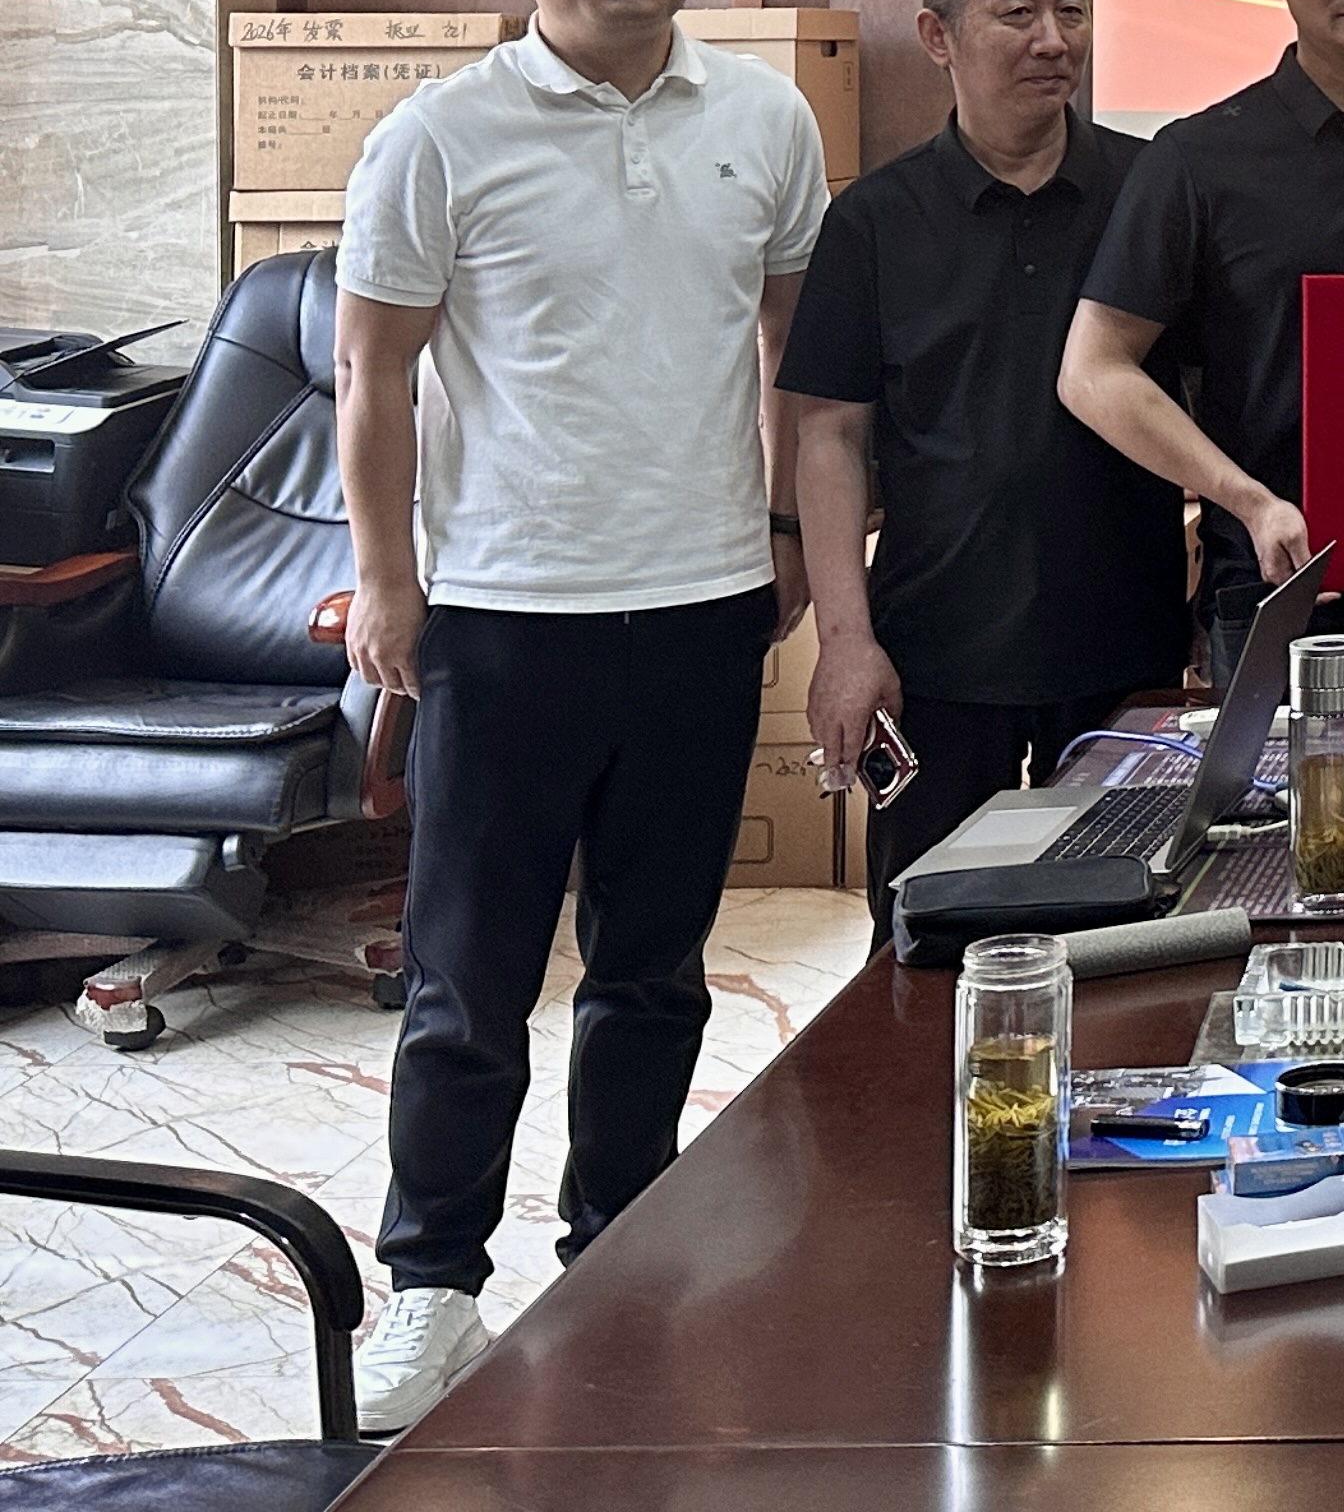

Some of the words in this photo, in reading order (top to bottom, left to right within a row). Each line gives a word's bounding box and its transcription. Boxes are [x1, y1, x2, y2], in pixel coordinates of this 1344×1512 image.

[240, 17, 292, 42] 2026年
[297, 63, 442, 81] 会计档案(凭证)
